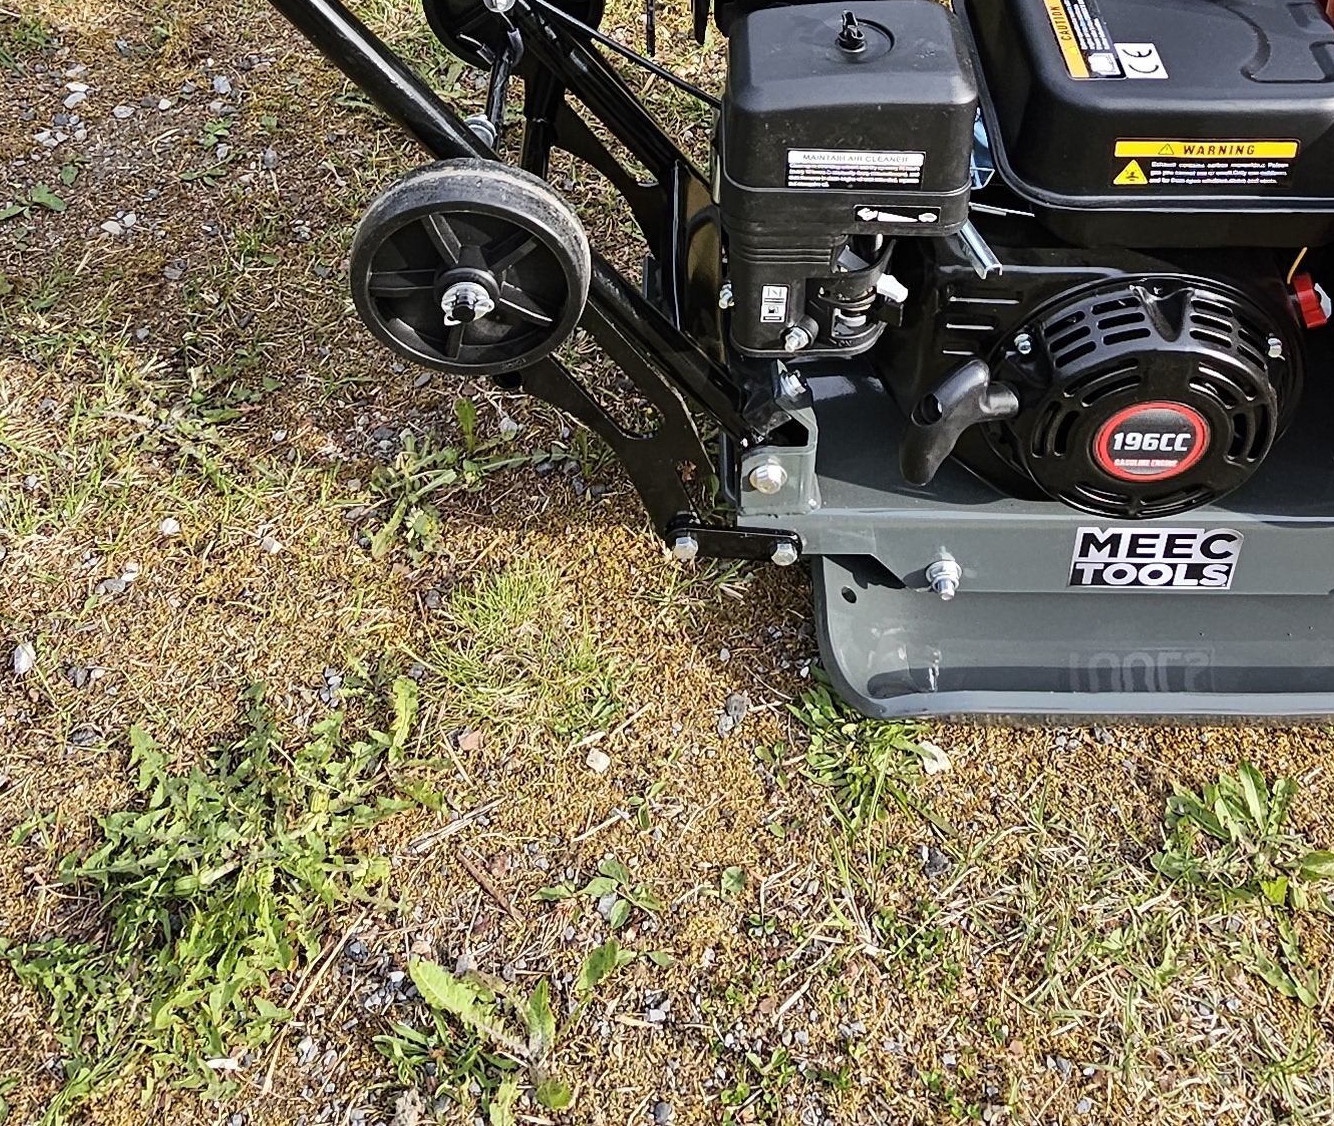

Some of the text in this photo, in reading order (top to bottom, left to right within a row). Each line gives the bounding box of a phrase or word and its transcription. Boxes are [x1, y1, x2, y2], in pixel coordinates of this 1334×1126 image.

[1050, 6, 1072, 41] CAUTION
[866, 154, 908, 163] CLEANER
[1183, 145, 1255, 155] WARNING
[1113, 432, 1191, 451] 196CC
[1078, 533, 1238, 560] MEEC
[1075, 563, 1229, 586] TOOLS
